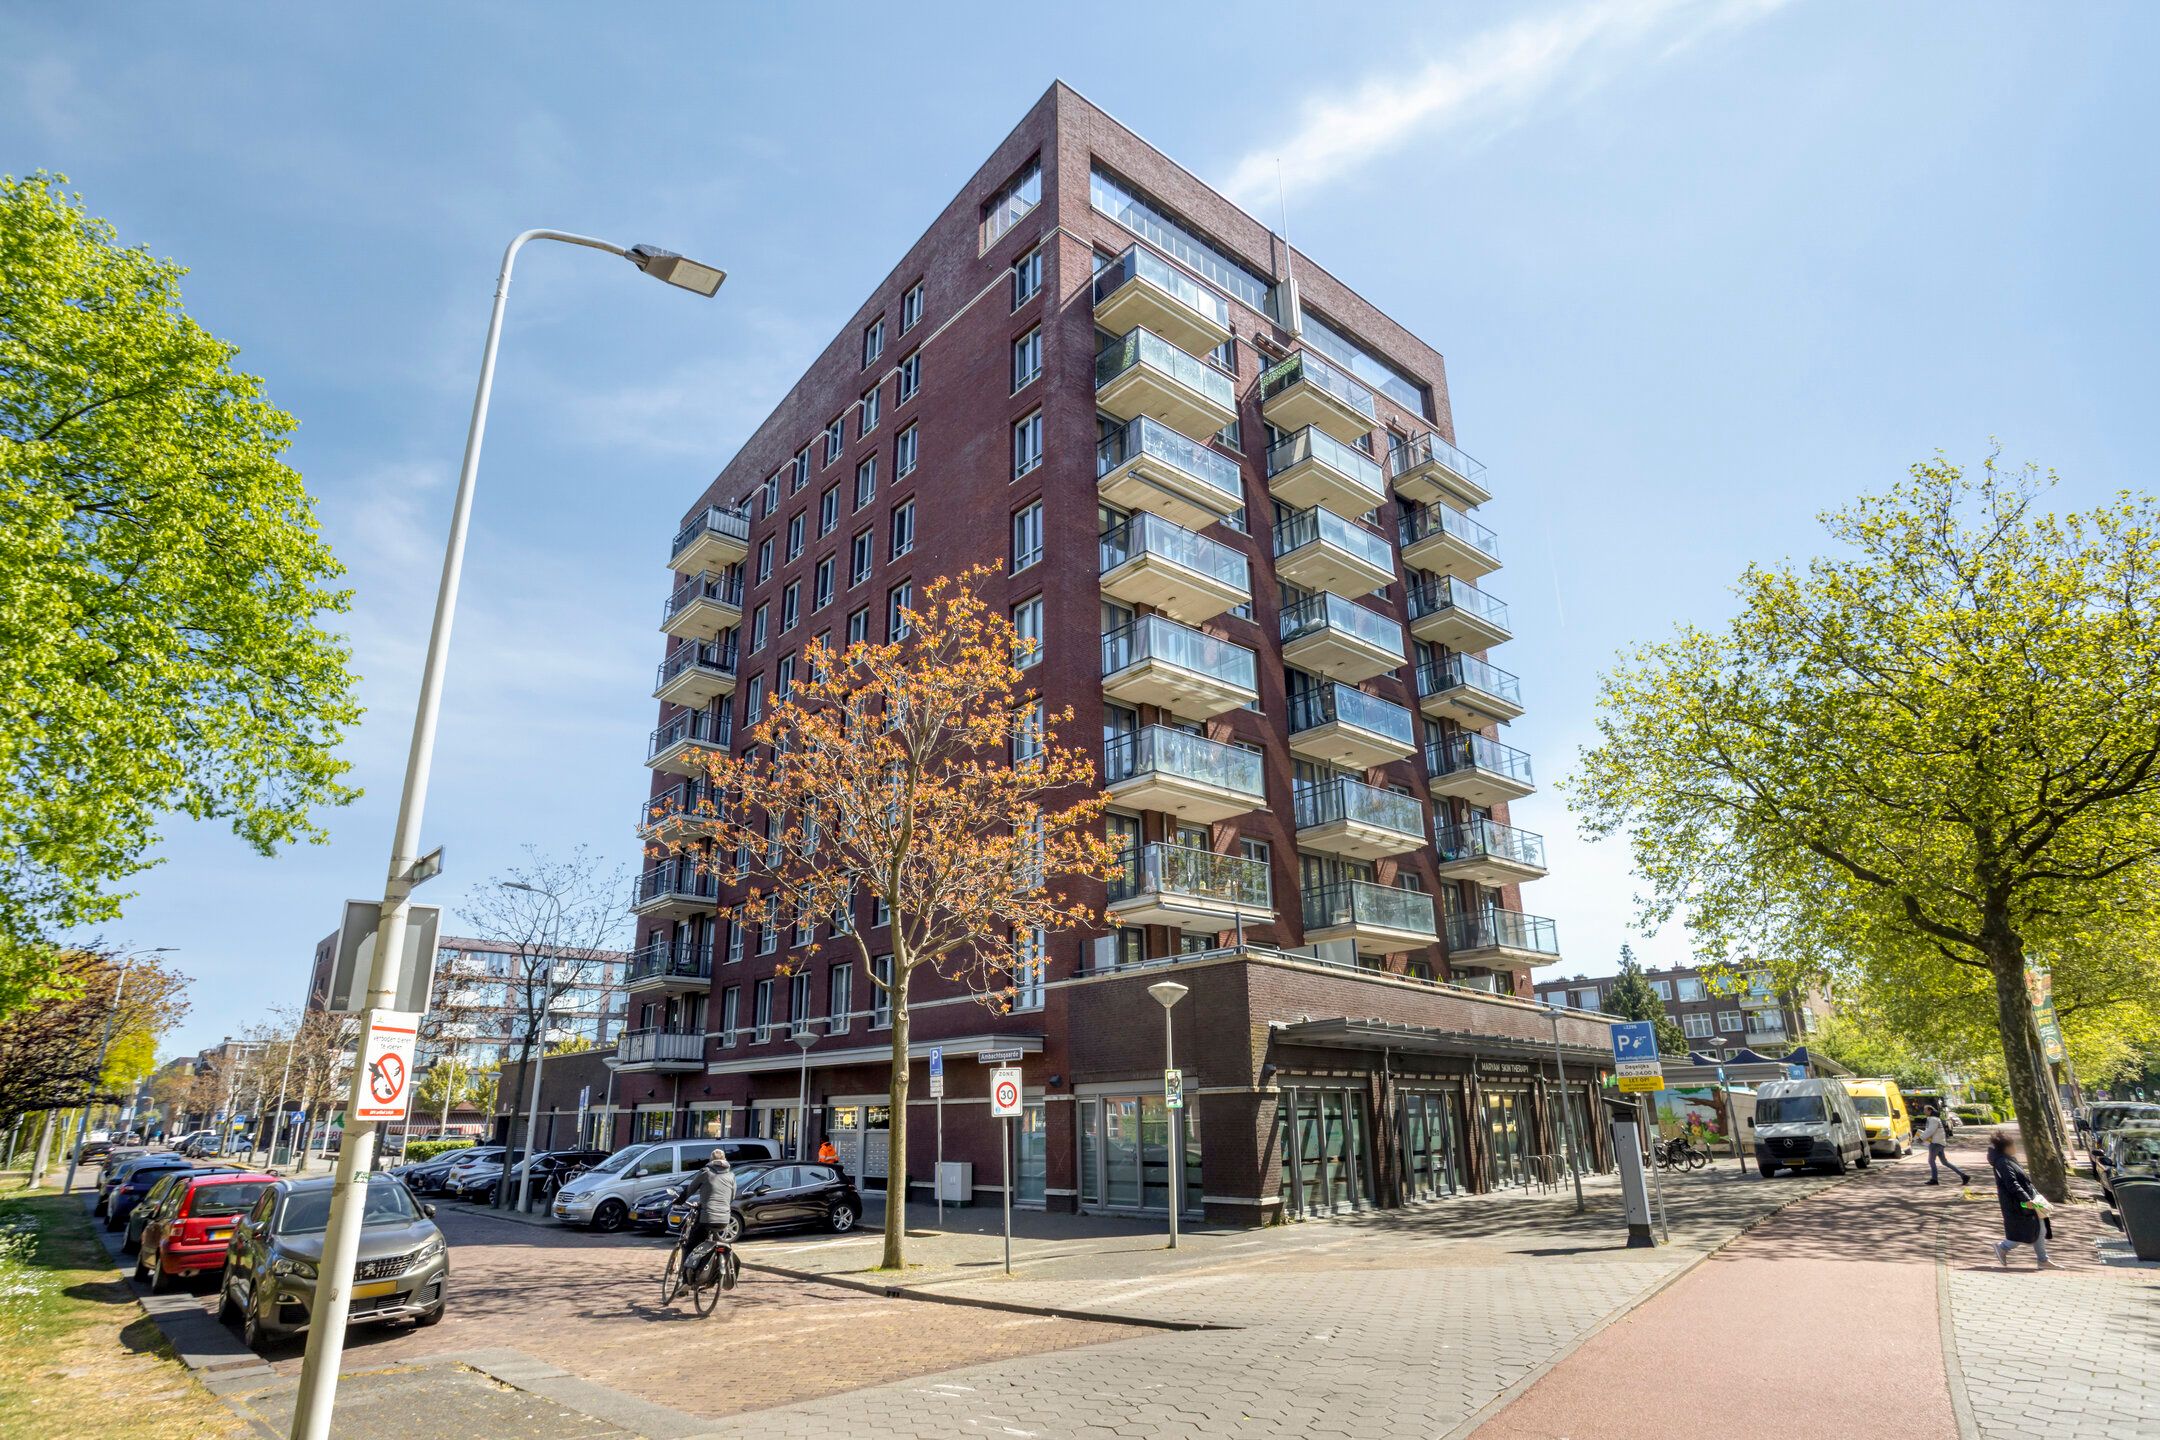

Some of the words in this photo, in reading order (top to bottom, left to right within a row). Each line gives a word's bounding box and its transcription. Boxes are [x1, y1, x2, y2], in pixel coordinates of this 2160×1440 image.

[1617, 1035, 1630, 1052] P
[932, 1050, 939, 1065] P
[980, 1051, 1019, 1061] Ambachtsgaarde
[1000, 1090, 1013, 1100] 30
